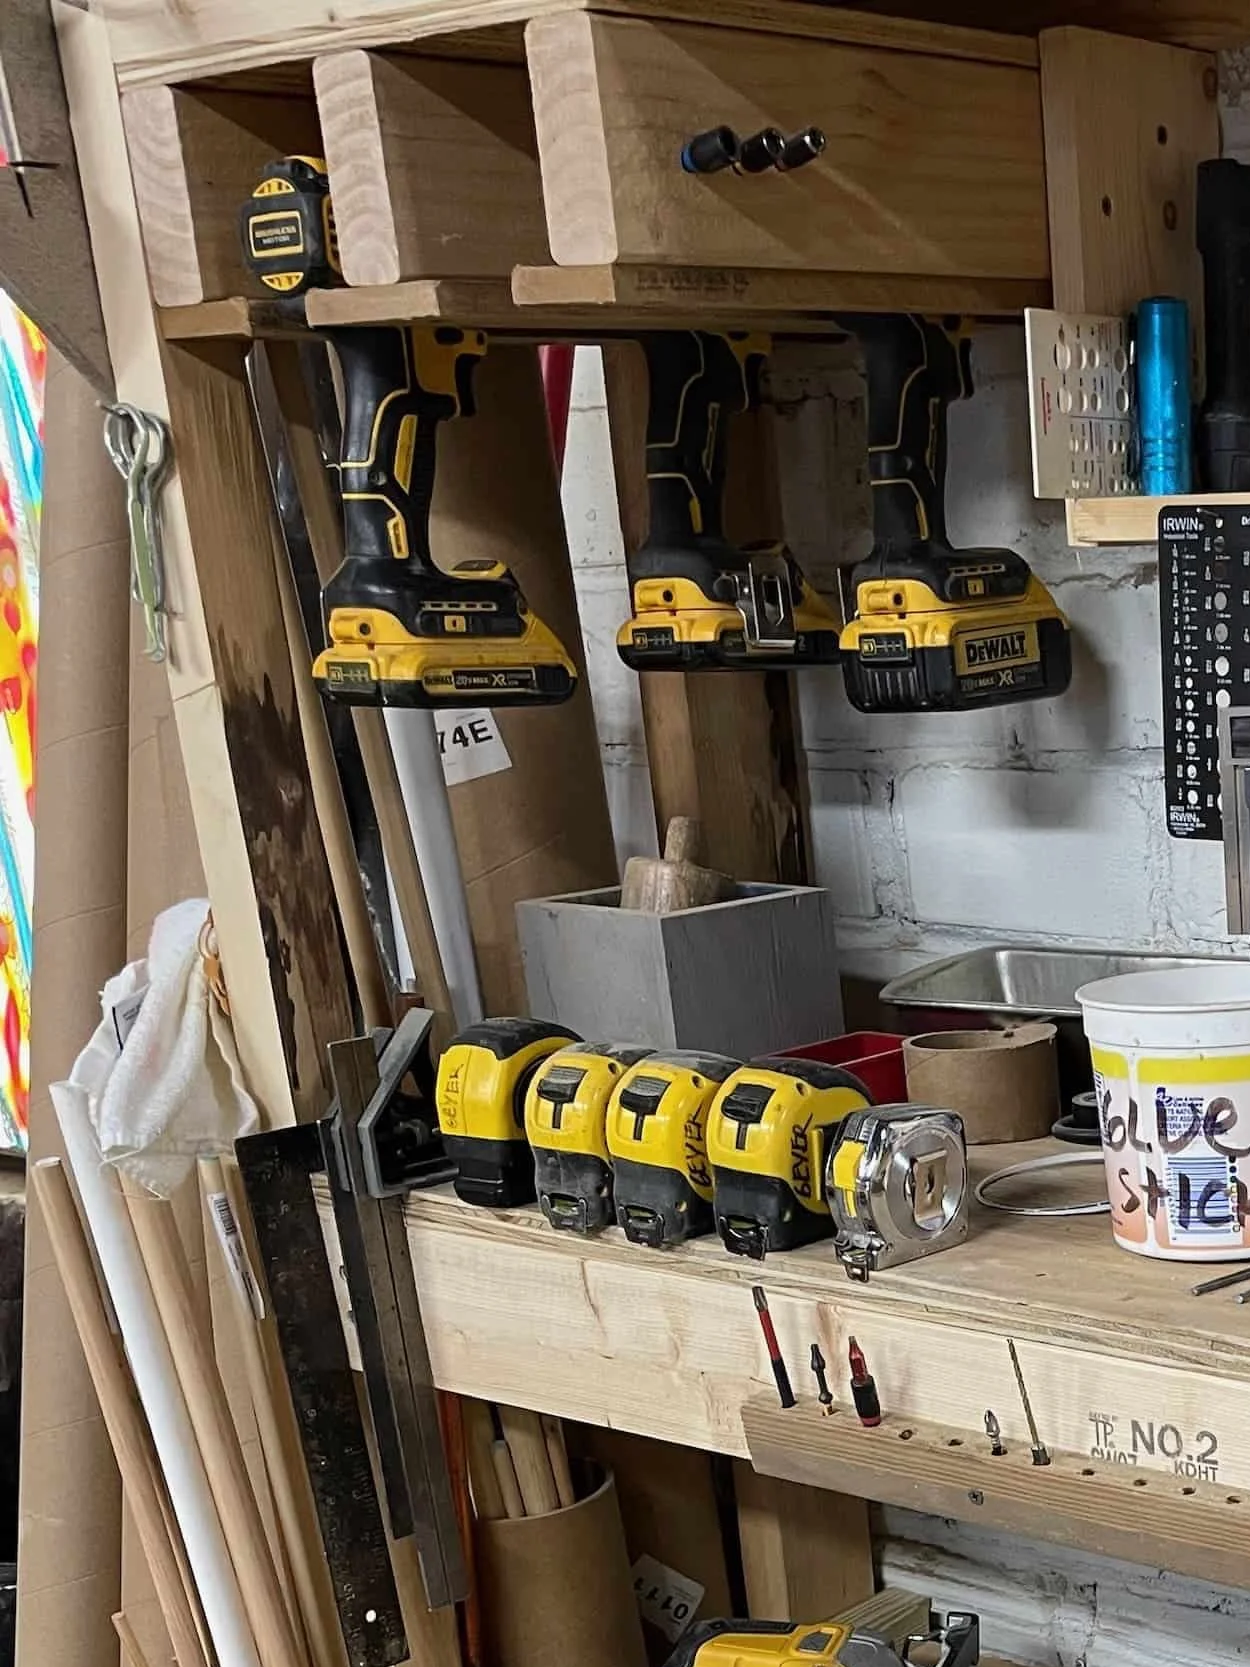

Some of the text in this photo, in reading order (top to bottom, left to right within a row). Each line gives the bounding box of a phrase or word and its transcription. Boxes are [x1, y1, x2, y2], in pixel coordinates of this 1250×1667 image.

[1163, 517, 1199, 531] IRWIN
[491, 673, 508, 687] XR
[999, 671, 1016, 686] XR
[790, 1113, 814, 1199] GEYER
